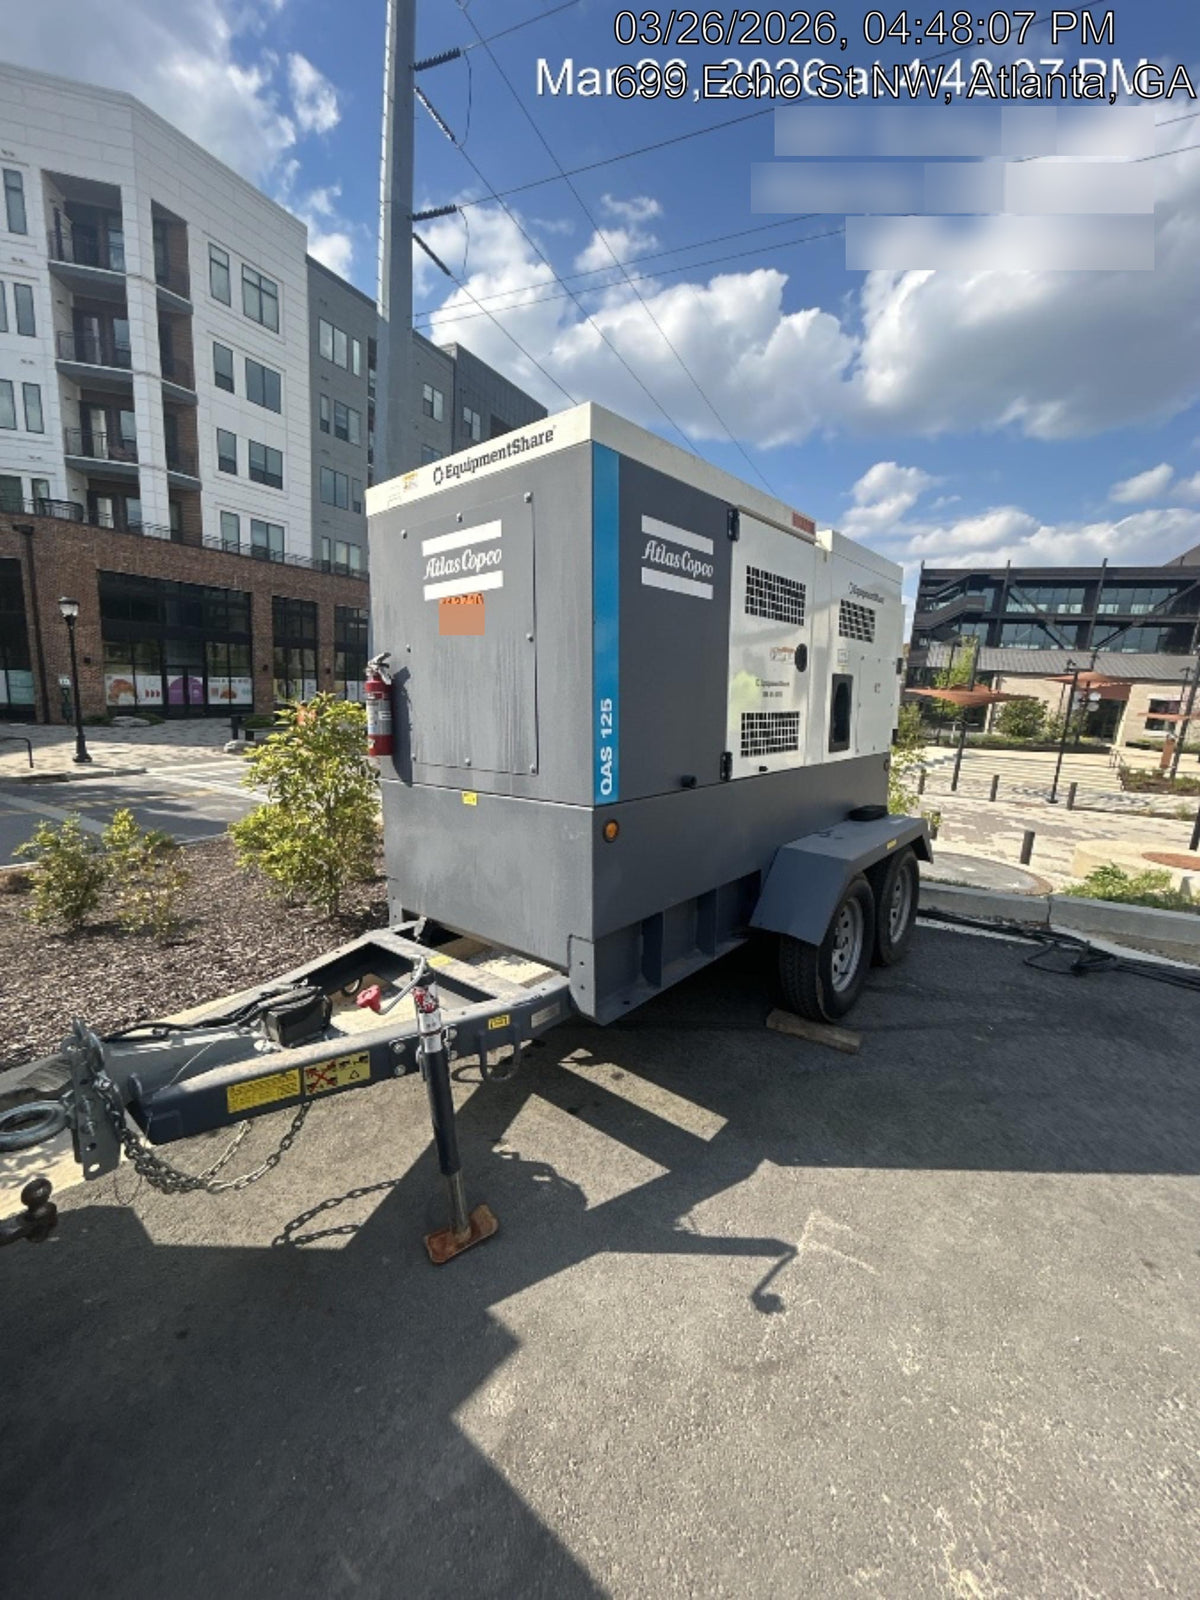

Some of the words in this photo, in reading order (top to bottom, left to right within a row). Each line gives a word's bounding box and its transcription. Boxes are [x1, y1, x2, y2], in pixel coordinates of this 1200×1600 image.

[445, 429, 554, 479] EquipmentShare
[423, 555, 461, 580] Atlas
[461, 548, 503, 573] Copco
[641, 540, 680, 569] Atlas
[681, 550, 714, 578] Copco
[600, 698, 613, 738] 125
[600, 746, 613, 795] QAS
